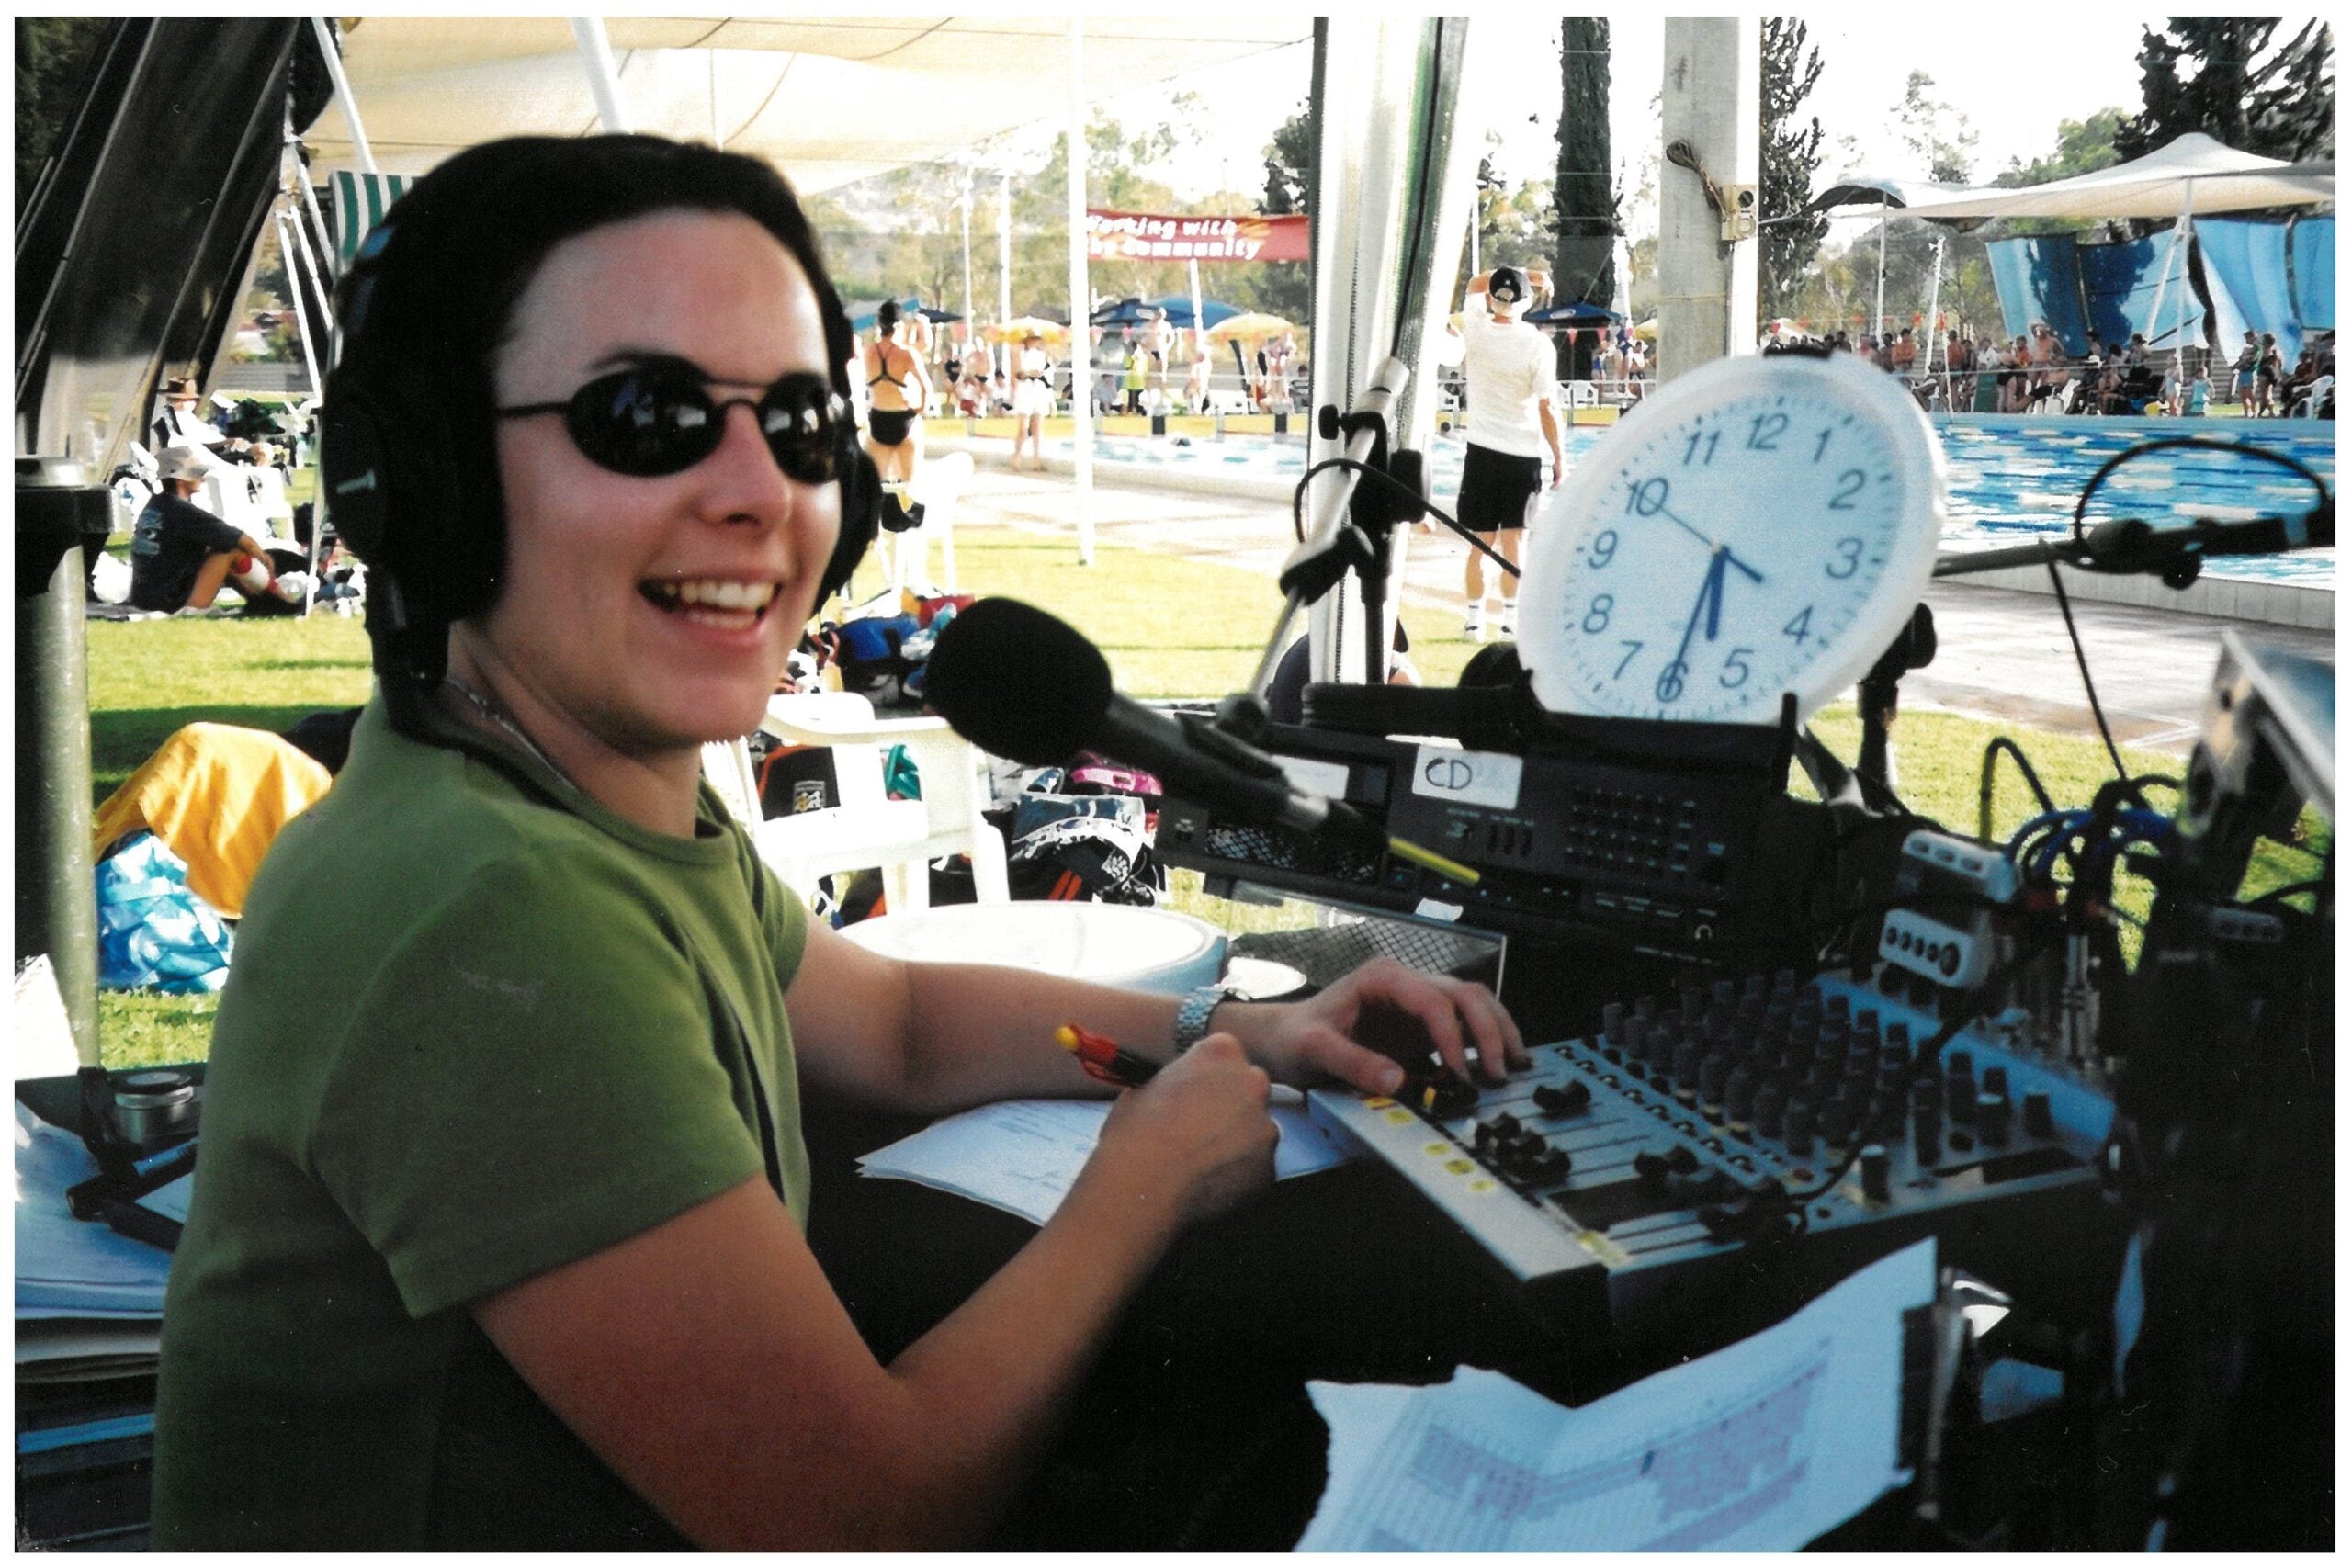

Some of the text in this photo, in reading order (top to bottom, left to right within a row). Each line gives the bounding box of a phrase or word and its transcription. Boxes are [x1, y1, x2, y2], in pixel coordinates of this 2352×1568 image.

[1087, 235, 1117, 256] he
[1182, 219, 1238, 236] with
[1683, 430, 1721, 466] 11
[1746, 412, 1789, 450] 12
[1812, 429, 1831, 463] 1
[1625, 477, 1670, 517] 10
[1828, 468, 1866, 511] 2
[1588, 530, 1617, 569] 9
[1826, 537, 1863, 579] 3
[1582, 593, 1614, 634] 8
[1783, 605, 1814, 643] 4
[1613, 640, 1644, 680] 7
[1718, 649, 1754, 688] 5
[1656, 659, 1690, 703] 6
[1425, 757, 1473, 790] CD
